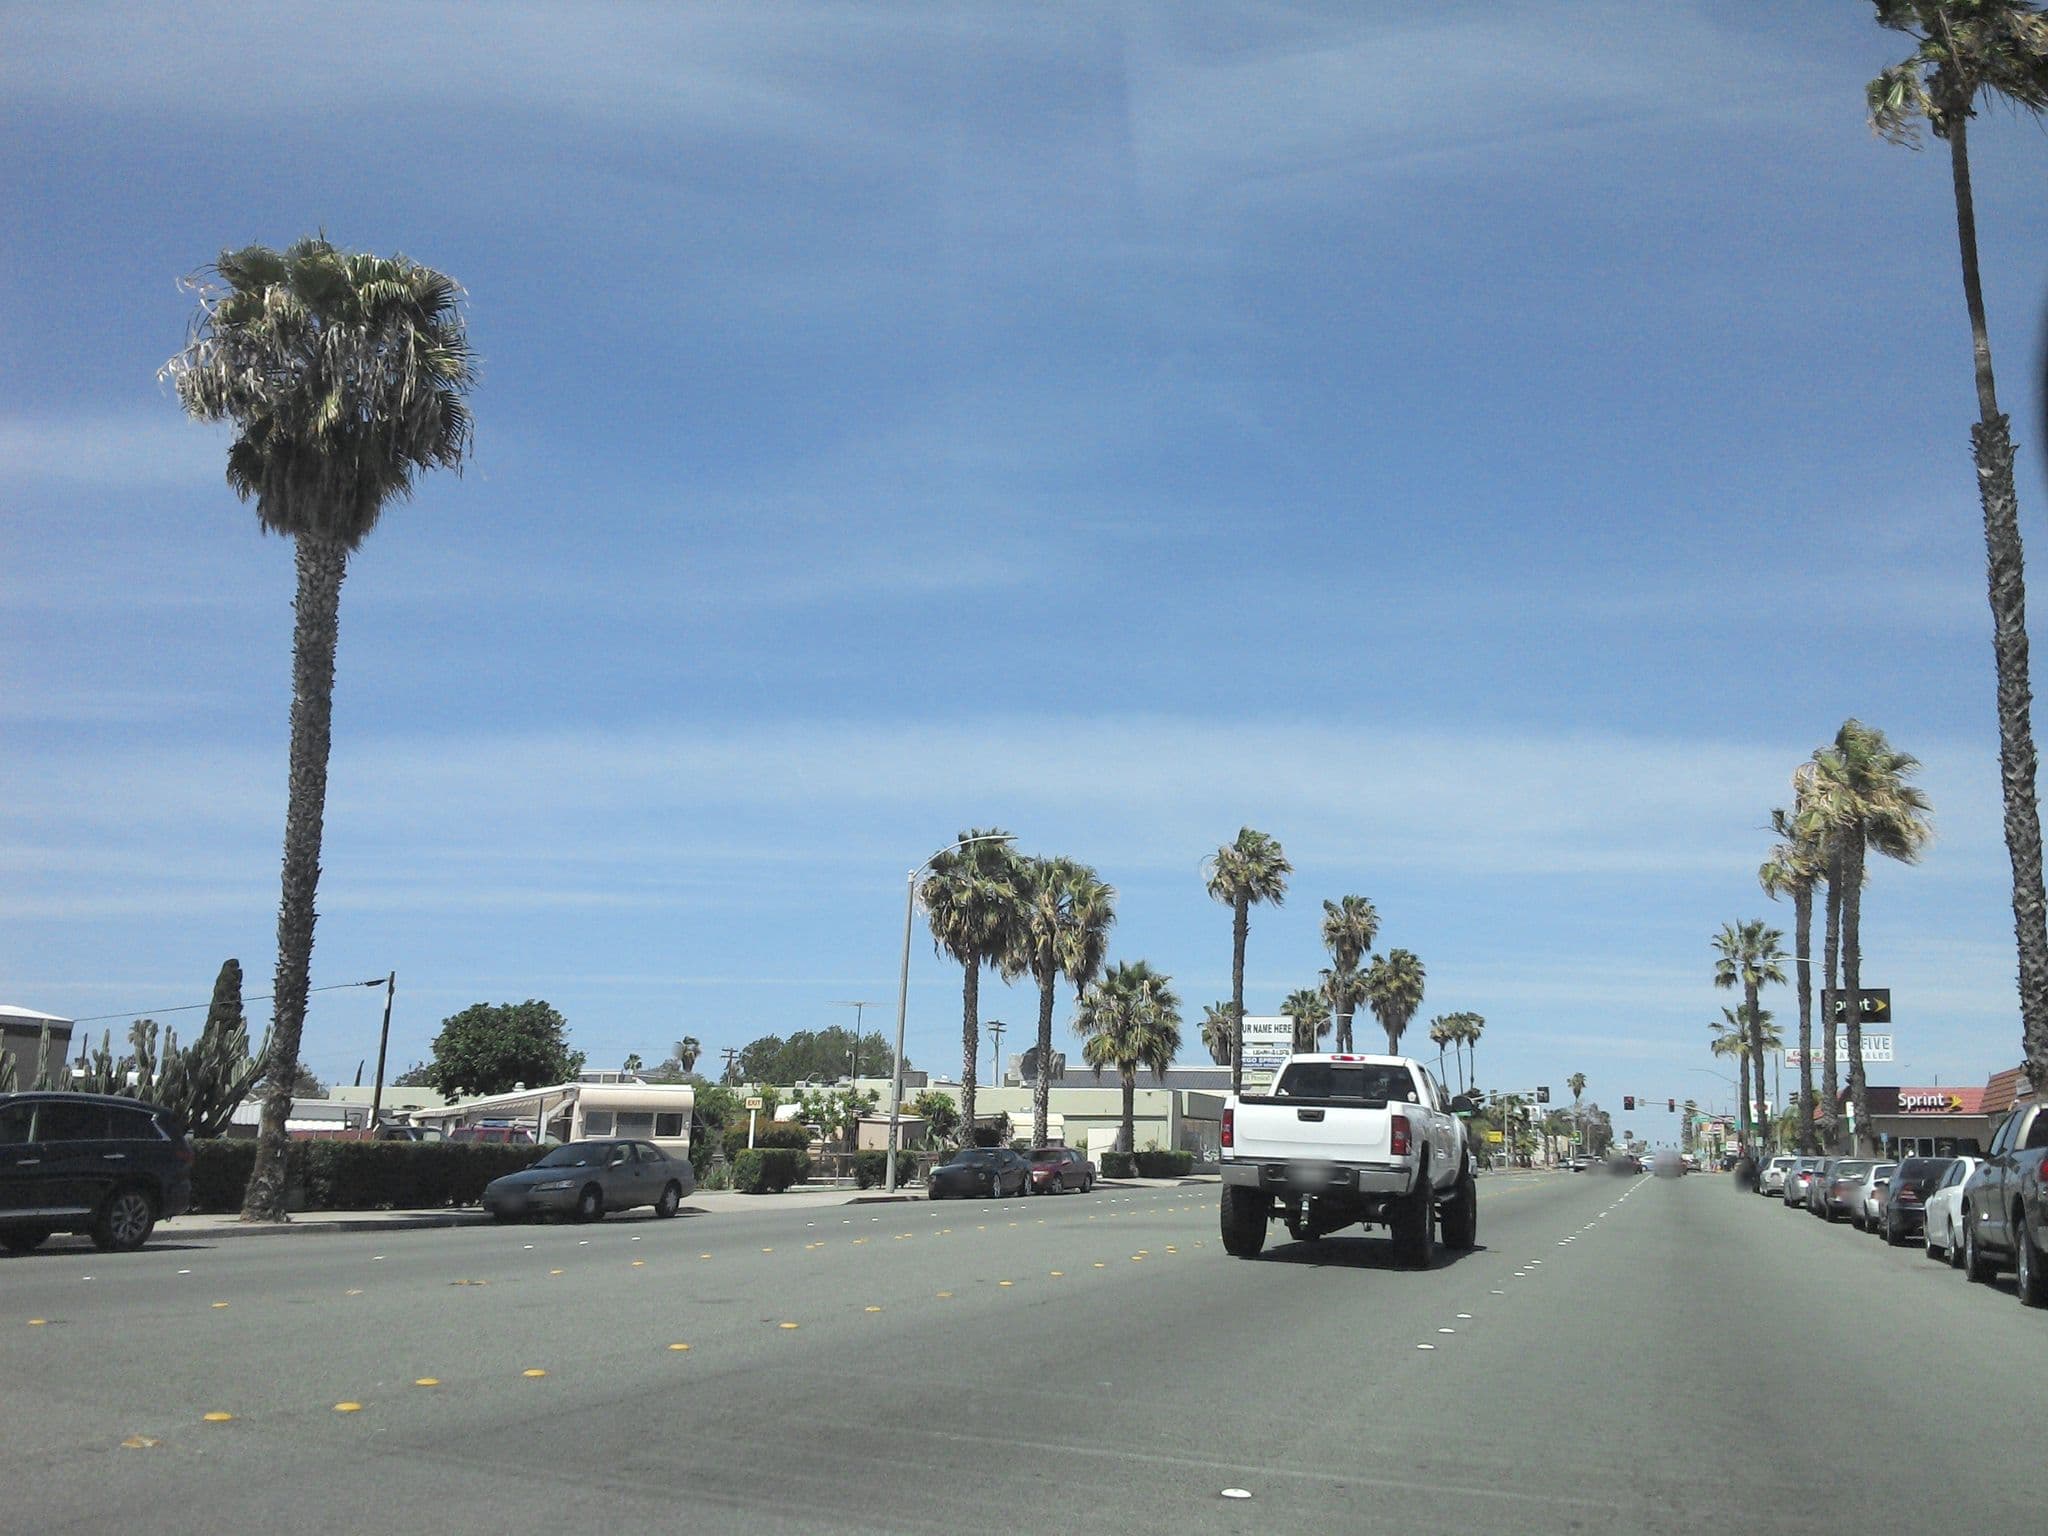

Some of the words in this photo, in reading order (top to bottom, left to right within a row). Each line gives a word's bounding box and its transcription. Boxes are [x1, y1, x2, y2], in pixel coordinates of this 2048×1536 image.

[1253, 1024, 1273, 1033] NAME
[1274, 1024, 1292, 1033] HERE
[1862, 1037, 1890, 1050] FIVE
[1898, 1092, 1945, 1110] Sprint
